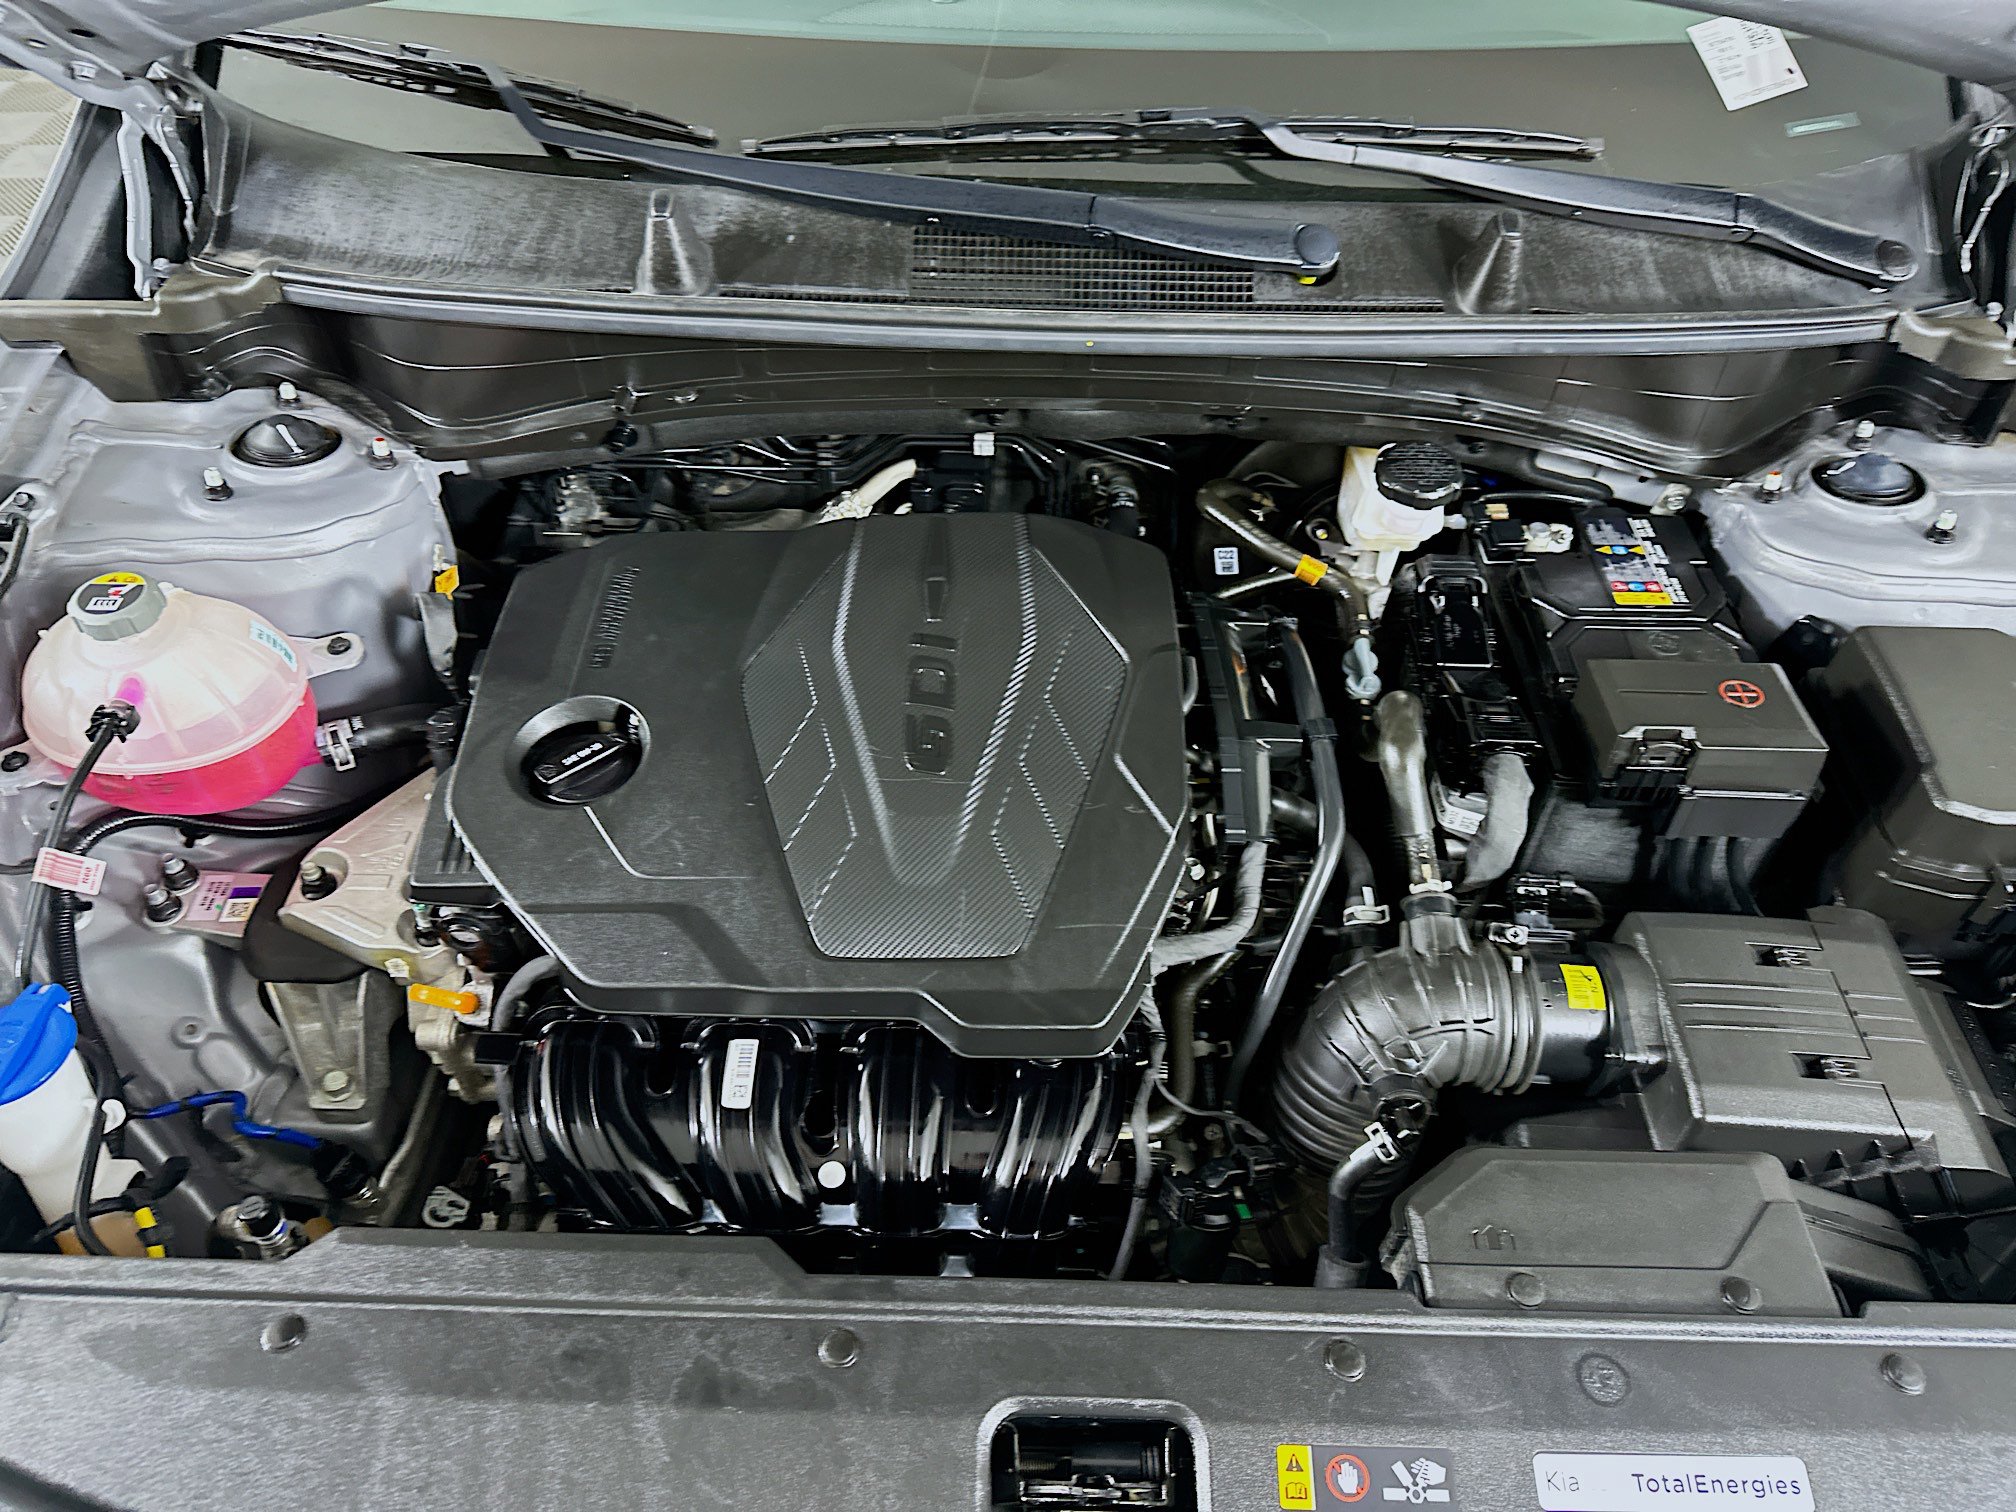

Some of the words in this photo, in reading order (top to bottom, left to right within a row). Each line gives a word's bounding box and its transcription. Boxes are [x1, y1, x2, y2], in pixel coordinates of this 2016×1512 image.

[904, 628, 958, 776] GDI
[1545, 1470, 1580, 1492] Kia
[1631, 1473, 1801, 1499] TotalEnergies
